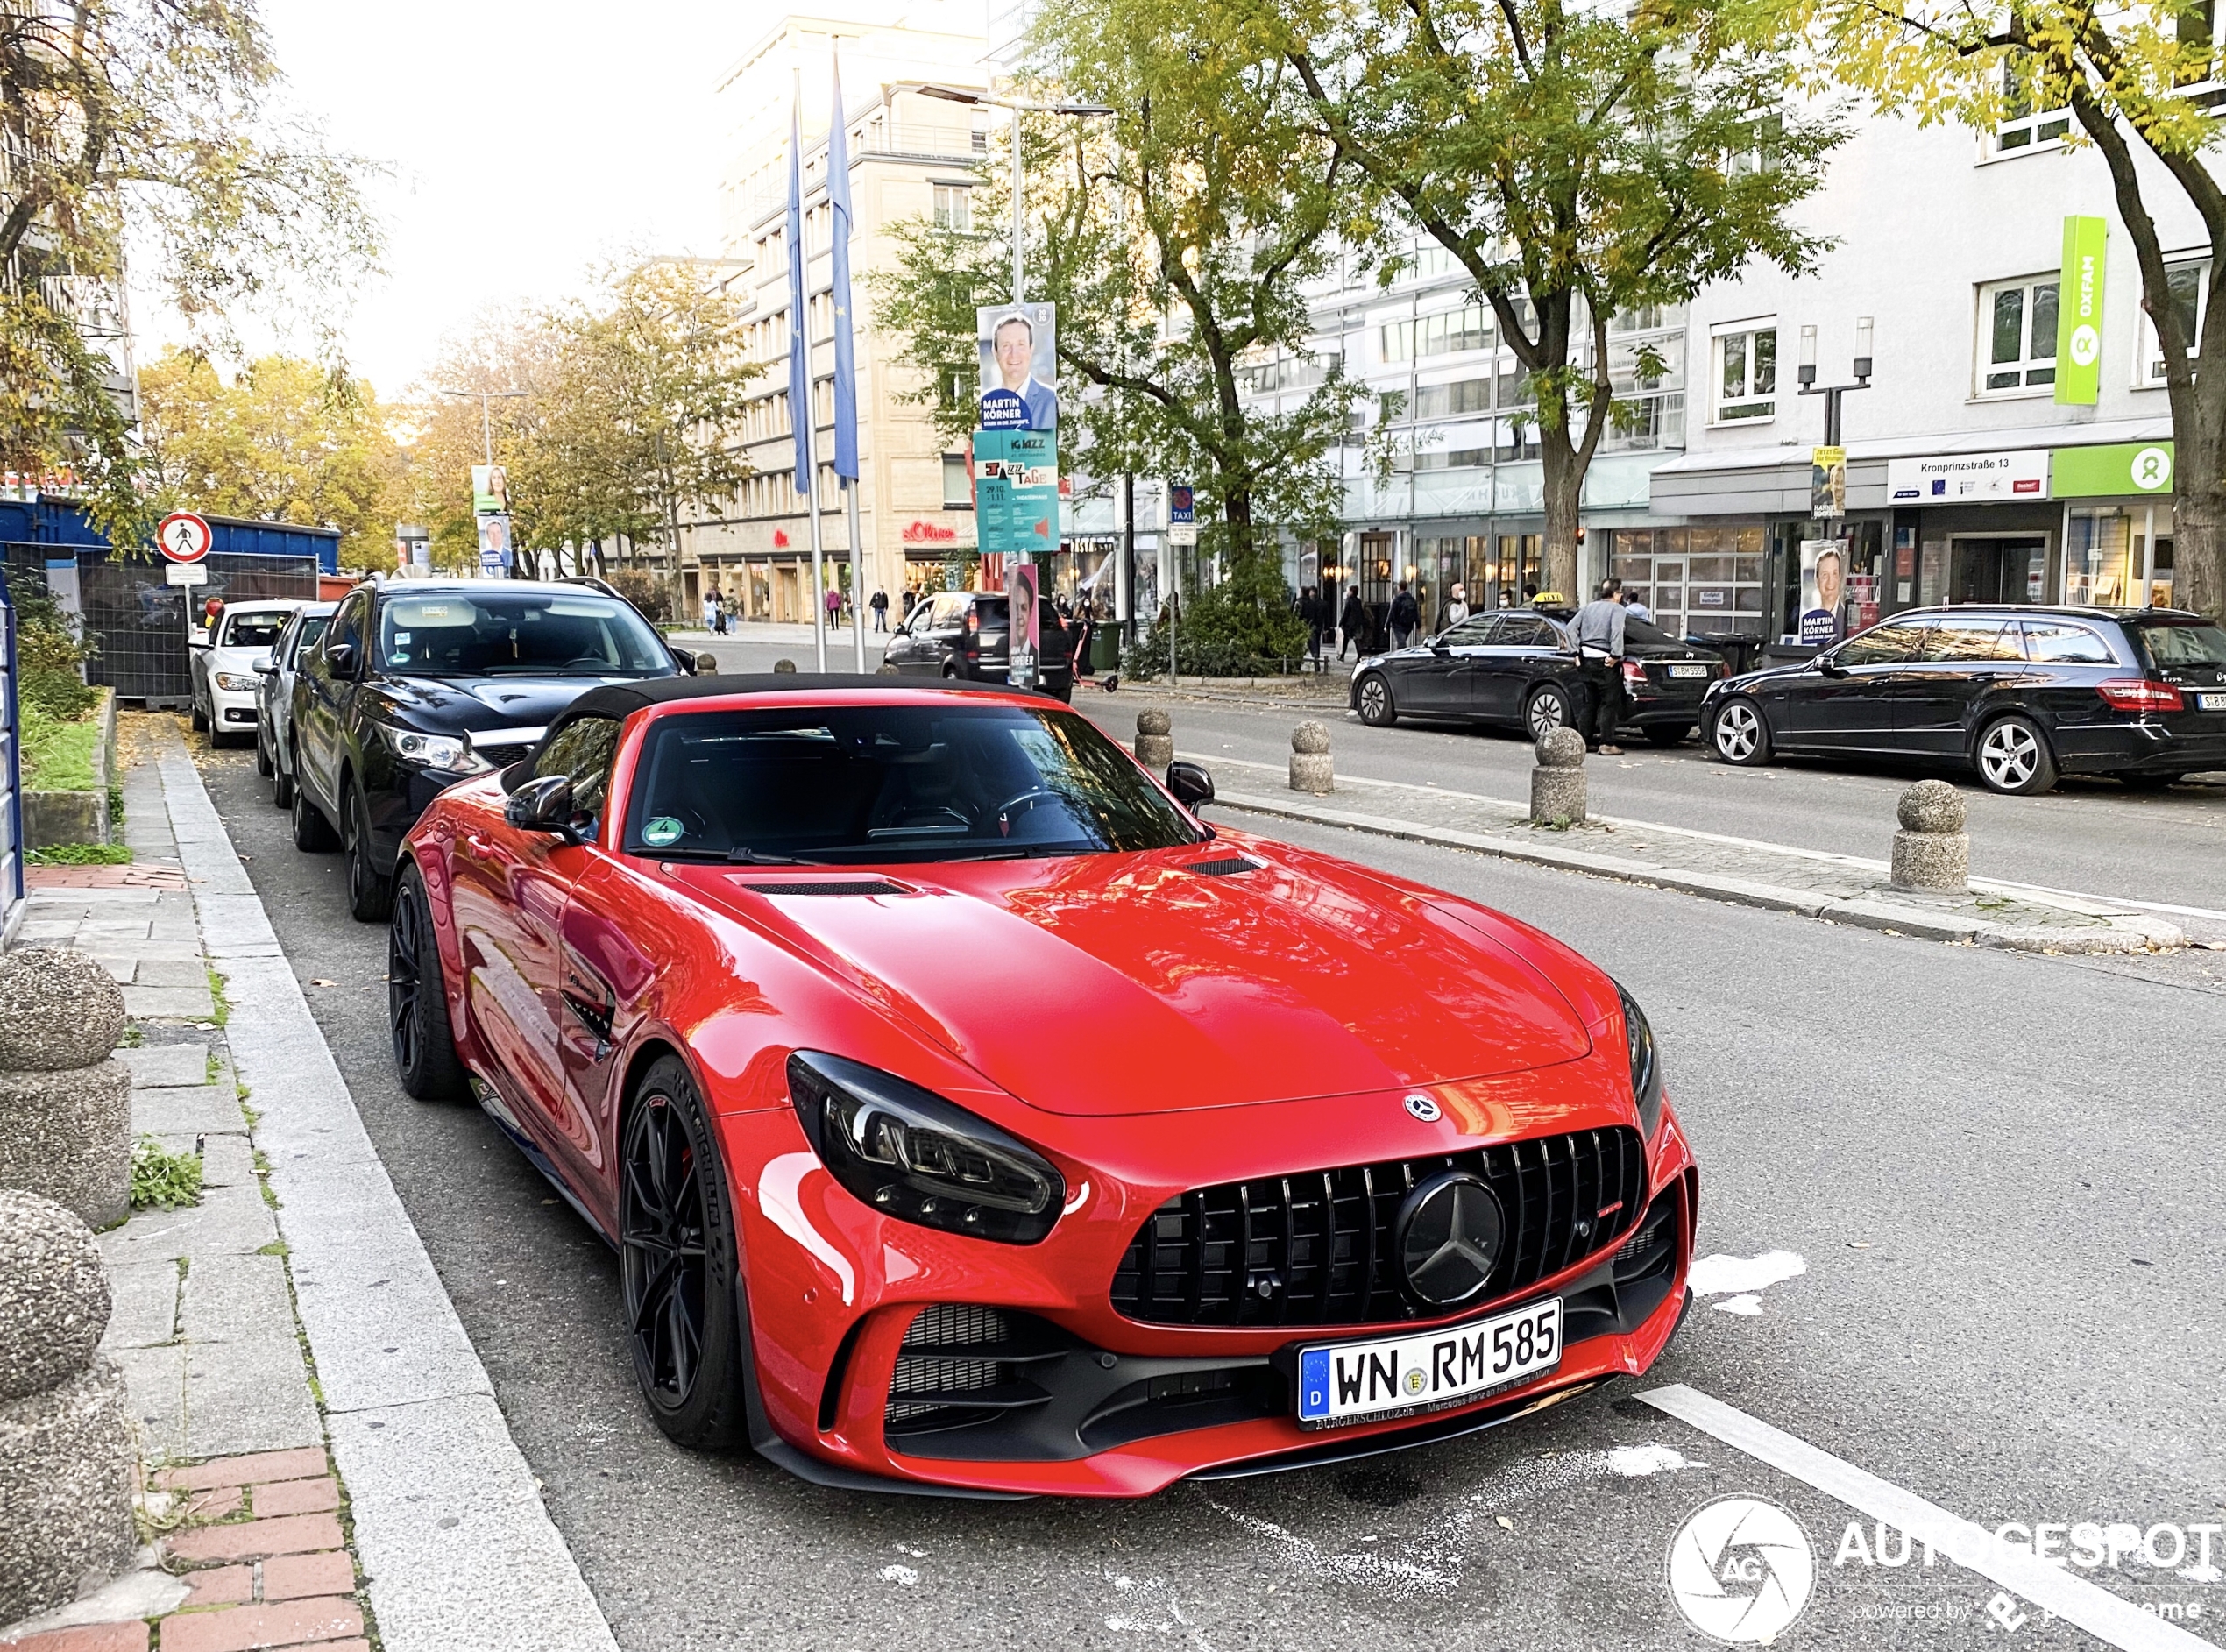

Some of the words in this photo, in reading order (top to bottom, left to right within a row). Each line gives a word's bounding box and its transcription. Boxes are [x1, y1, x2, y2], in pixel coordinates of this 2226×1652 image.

[2080, 255, 2095, 317] OXFAM
[982, 398, 1020, 409] MARTIN
[983, 408, 1021, 420] KÖRNER
[1921, 460, 1995, 473] Kronprinzstraße
[1998, 458, 2009, 468] 13
[1173, 511, 1192, 520] TAXI
[1804, 616, 1833, 626] MARTIN
[1804, 625, 1833, 635] KÖRNER
[658, 820, 669, 833] 4
[1336, 1349, 1398, 1406] WN
[1432, 1332, 1484, 1392] RM
[1493, 1309, 1555, 1374] 585
[1310, 1390, 1321, 1407] D
[1427, 1391, 1485, 1413] Mercedes-Benz
